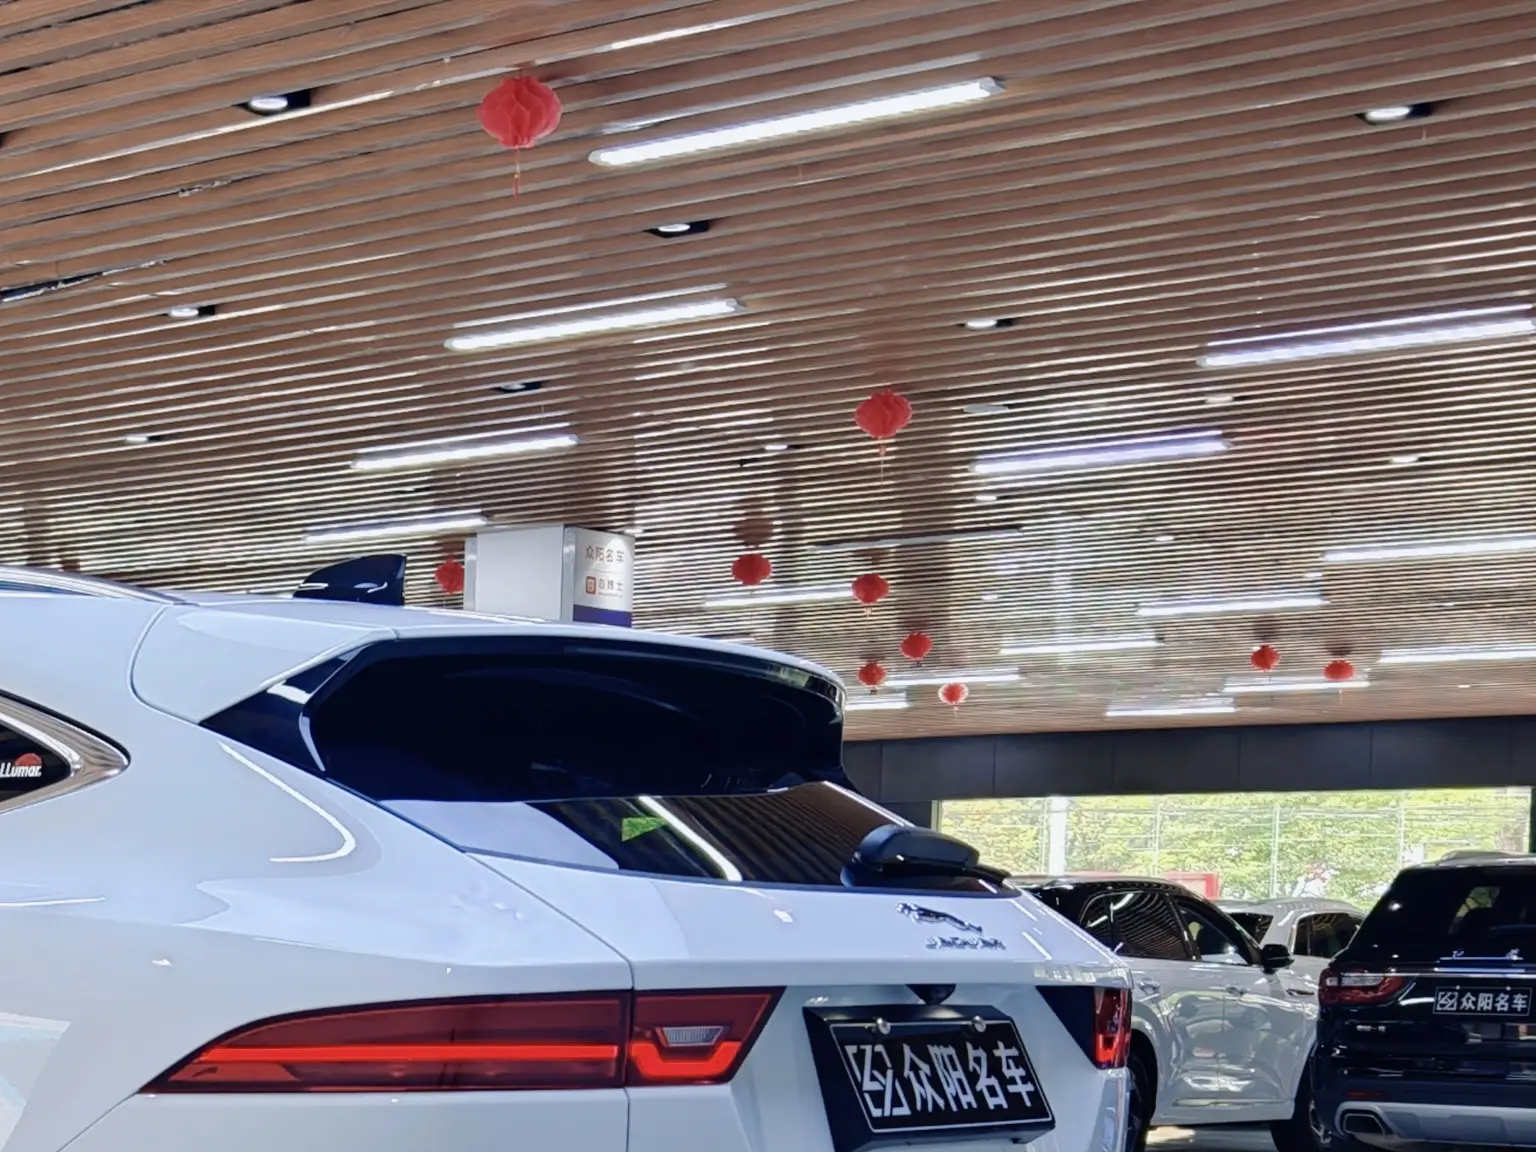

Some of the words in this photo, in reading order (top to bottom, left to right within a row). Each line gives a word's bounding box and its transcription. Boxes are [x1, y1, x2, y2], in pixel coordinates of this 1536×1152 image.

[1459, 992, 1529, 1012] 众阳名车
[902, 1039, 1036, 1113] 众阳名车
